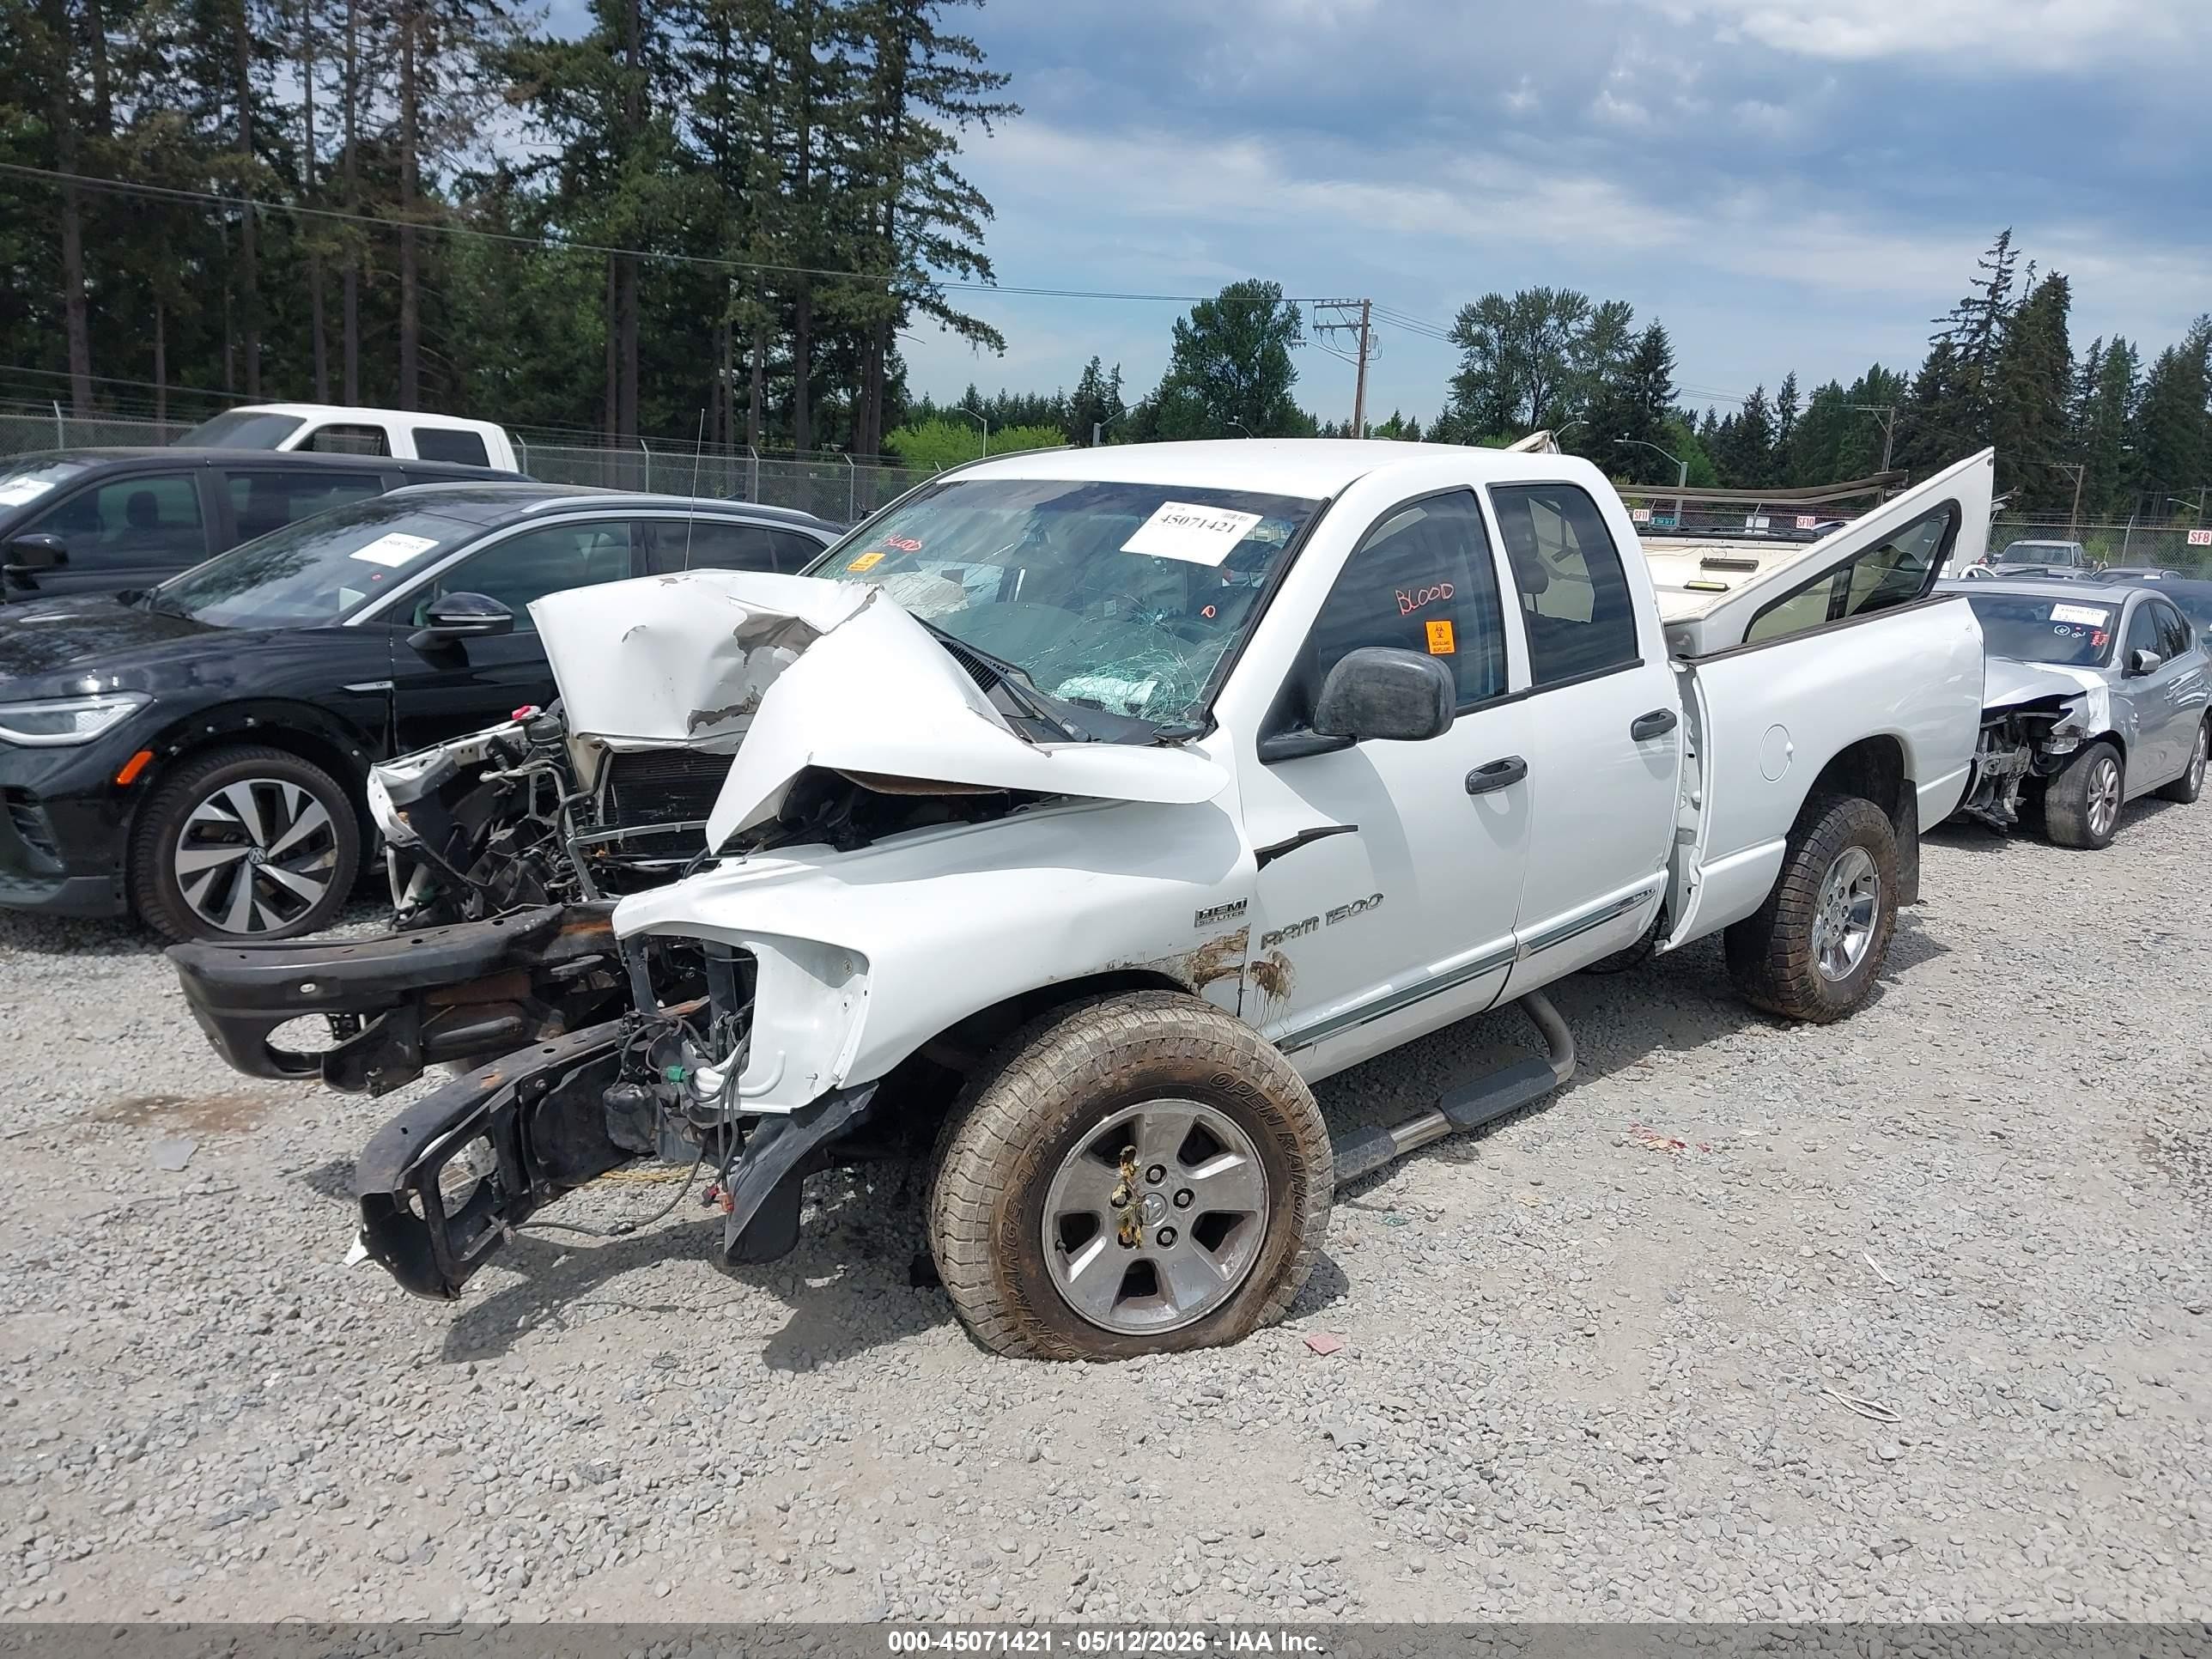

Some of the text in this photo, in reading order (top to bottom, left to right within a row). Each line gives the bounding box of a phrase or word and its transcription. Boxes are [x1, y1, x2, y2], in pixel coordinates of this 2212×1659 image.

[1161, 514, 1237, 532] 45071421
[1634, 511, 1648, 520] SF11
[1797, 517, 1814, 527] SF10
[2190, 531, 2209, 543] SF8
[1395, 584, 1454, 615] BLOOD
[1198, 899, 1248, 919] HEMI
[1260, 893, 1384, 951] RAM 1500
[1208, 1072, 1286, 1126] OPEN
[1275, 1130, 1308, 1240] RANGE
